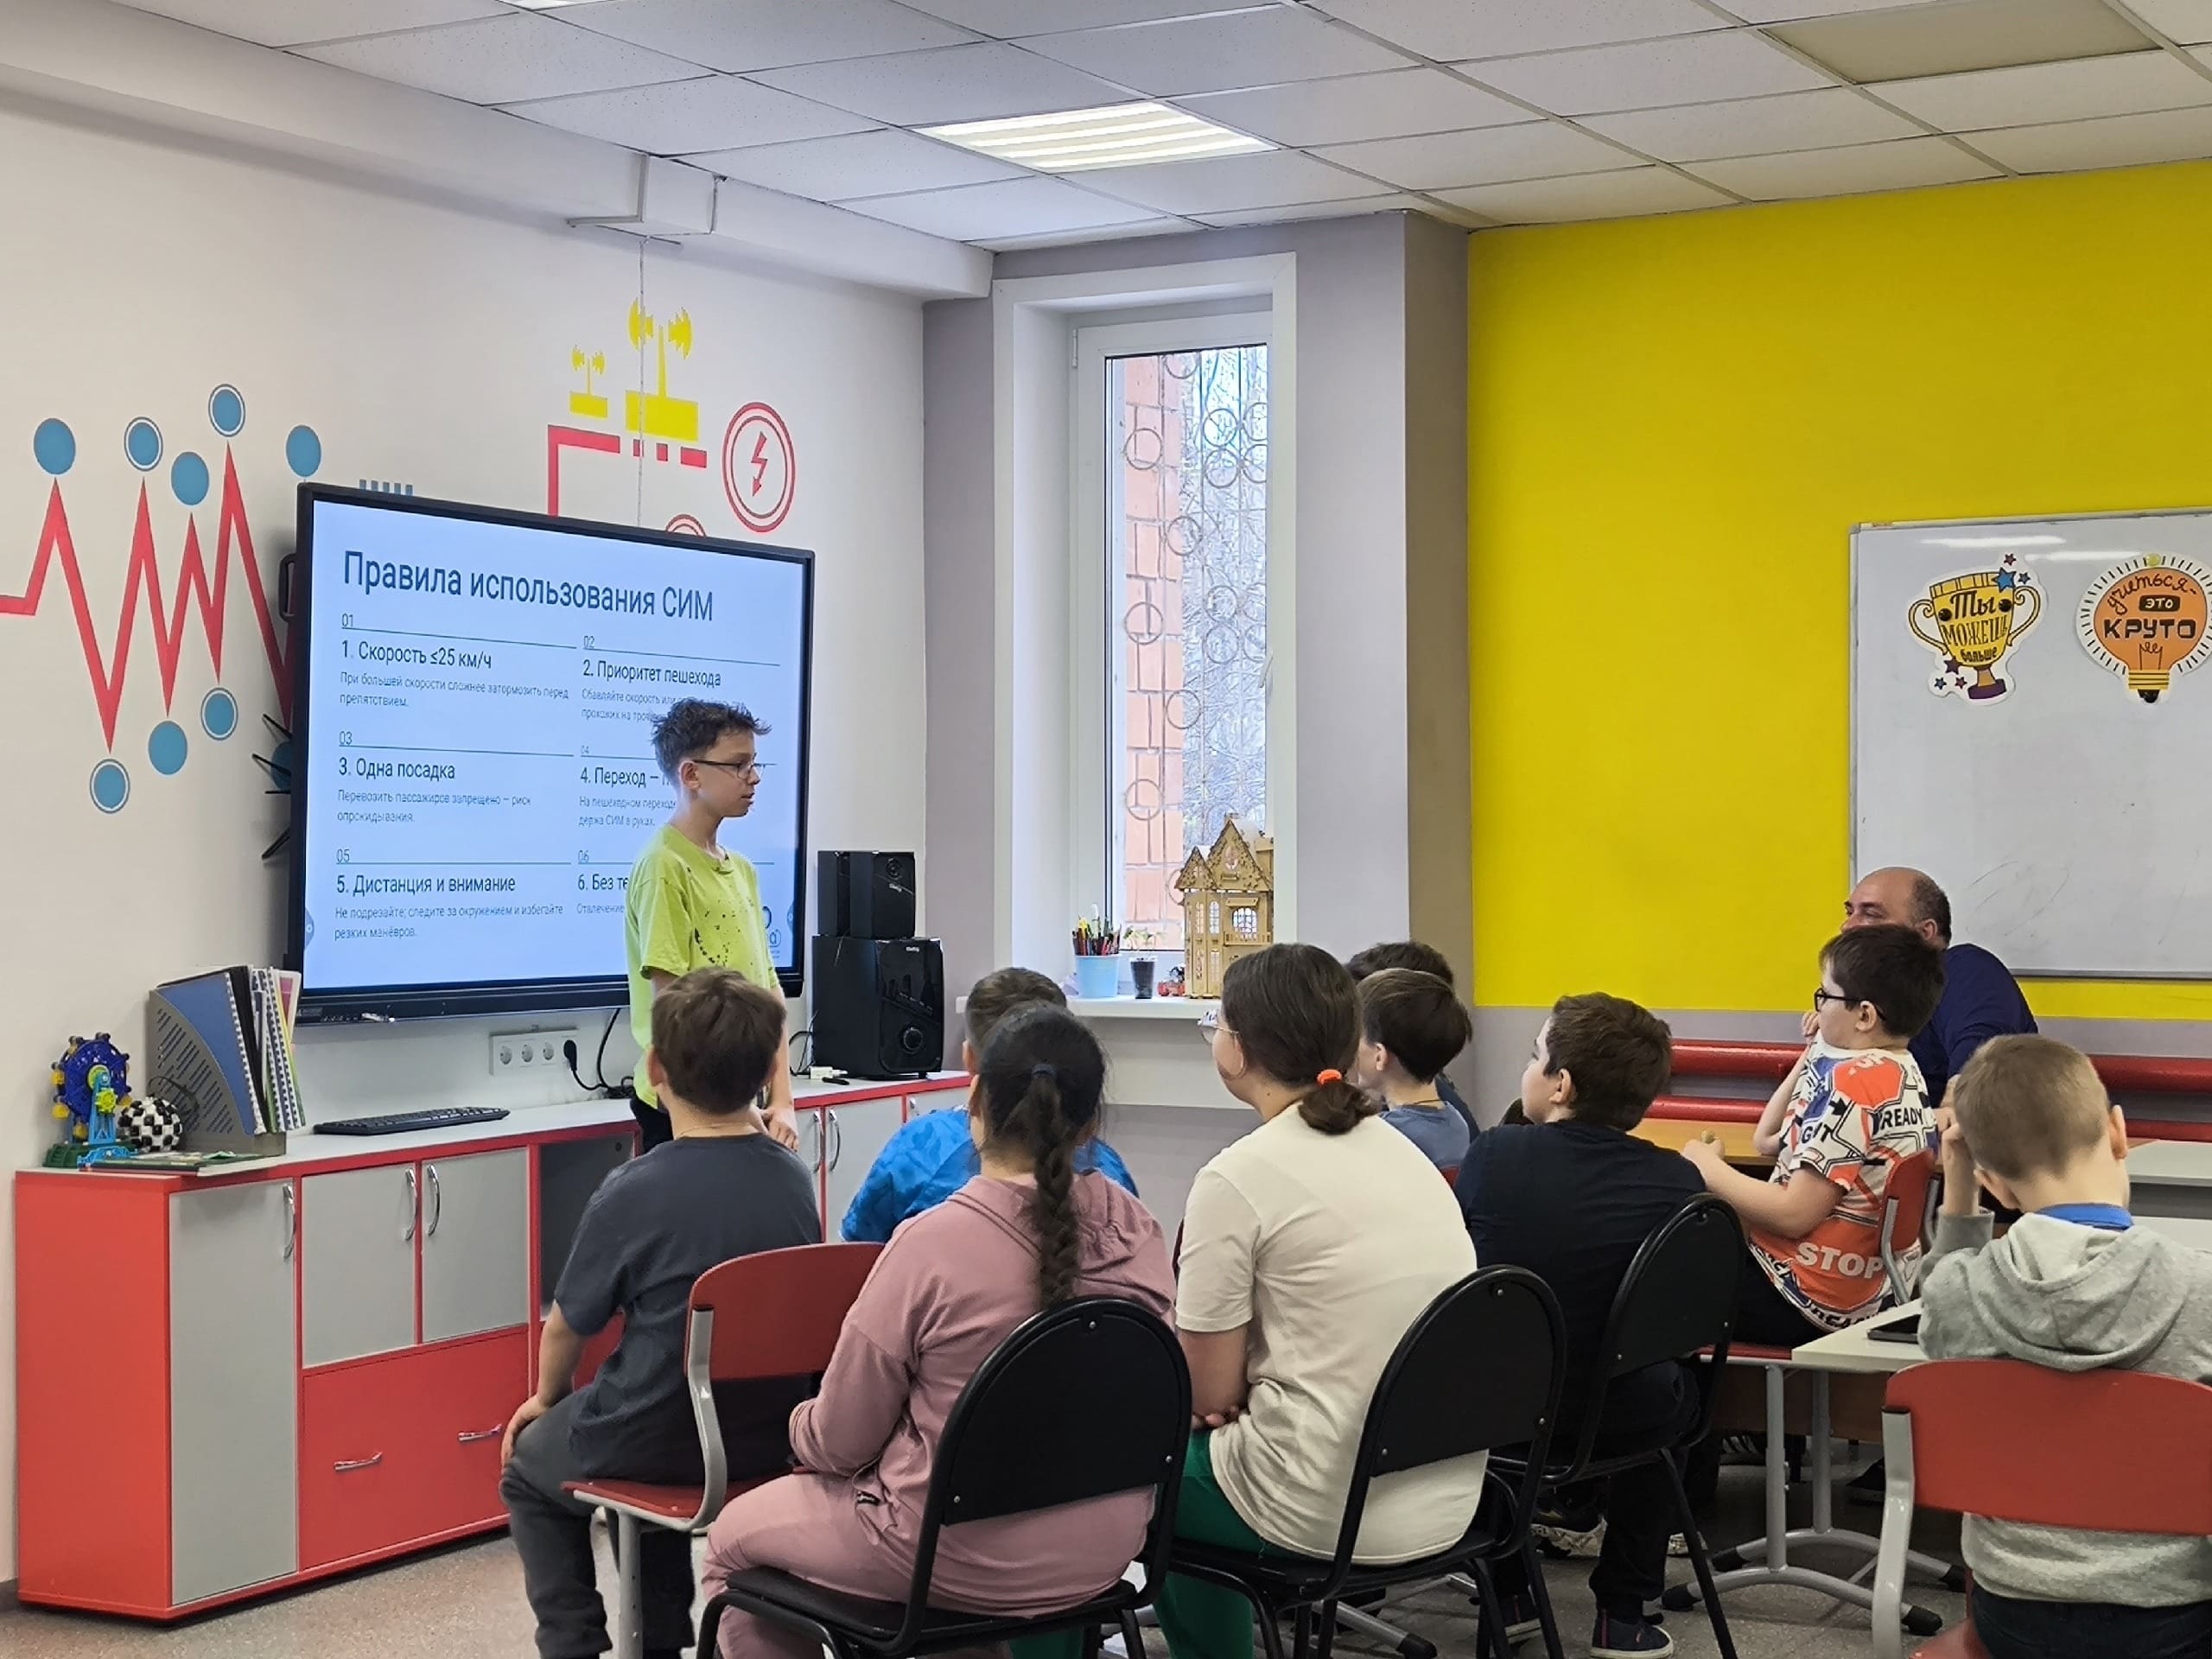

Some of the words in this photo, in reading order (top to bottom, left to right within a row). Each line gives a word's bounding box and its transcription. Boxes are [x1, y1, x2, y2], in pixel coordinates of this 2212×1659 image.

[345, 550, 461, 594] Правила
[471, 573, 655, 614] использования
[663, 587, 713, 620] СИМ
[1949, 590, 1997, 619] Ты
[341, 613, 353, 627] 01
[2103, 619, 2196, 639] КРУТО
[583, 636, 594, 648] 02
[359, 641, 427, 665] Скорость
[458, 652, 492, 669] км/ч
[583, 659, 594, 677] 2.
[598, 661, 661, 683] Приоритет
[664, 669, 721, 688] пешехода
[340, 671, 359, 688] При
[361, 673, 403, 687] большей
[405, 677, 446, 691] скорости
[448, 681, 486, 692] сложнее
[487, 683, 542, 697] затормозить
[543, 687, 569, 700] перед
[582, 688, 624, 702] Сбавляйте
[625, 693, 660, 706] скорость
[661, 696, 676, 705] или
[581, 708, 620, 721] прохожих
[620, 711, 631, 721] на
[339, 731, 353, 745] 03
[339, 757, 352, 776] 3.
[356, 758, 393, 779] Одна
[397, 763, 455, 781] посадка
[580, 766, 591, 784] 4.
[594, 766, 646, 788] Переход
[338, 789, 393, 803] Перевозить
[395, 791, 450, 804] пассажиров
[452, 794, 501, 806] запрещено
[512, 795, 531, 807] риск
[579, 796, 590, 807] На
[606, 815, 624, 825] СИМ
[336, 849, 350, 863] 05
[578, 849, 589, 862] 06
[337, 874, 349, 893] 5.
[353, 874, 432, 897] Дистанция
[436, 878, 445, 893] и
[448, 877, 516, 893] внимание
[577, 874, 588, 890] 6.
[592, 874, 613, 890] Без
[334, 906, 347, 918] Не
[408, 907, 445, 919] следите
[447, 907, 458, 918] за
[459, 906, 512, 919] окружением
[513, 907, 520, 917] и
[521, 904, 564, 917] избегайте
[334, 927, 367, 942] резких
[1880, 1108, 1924, 1130] READY
[1795, 1242, 1885, 1279] STOP
